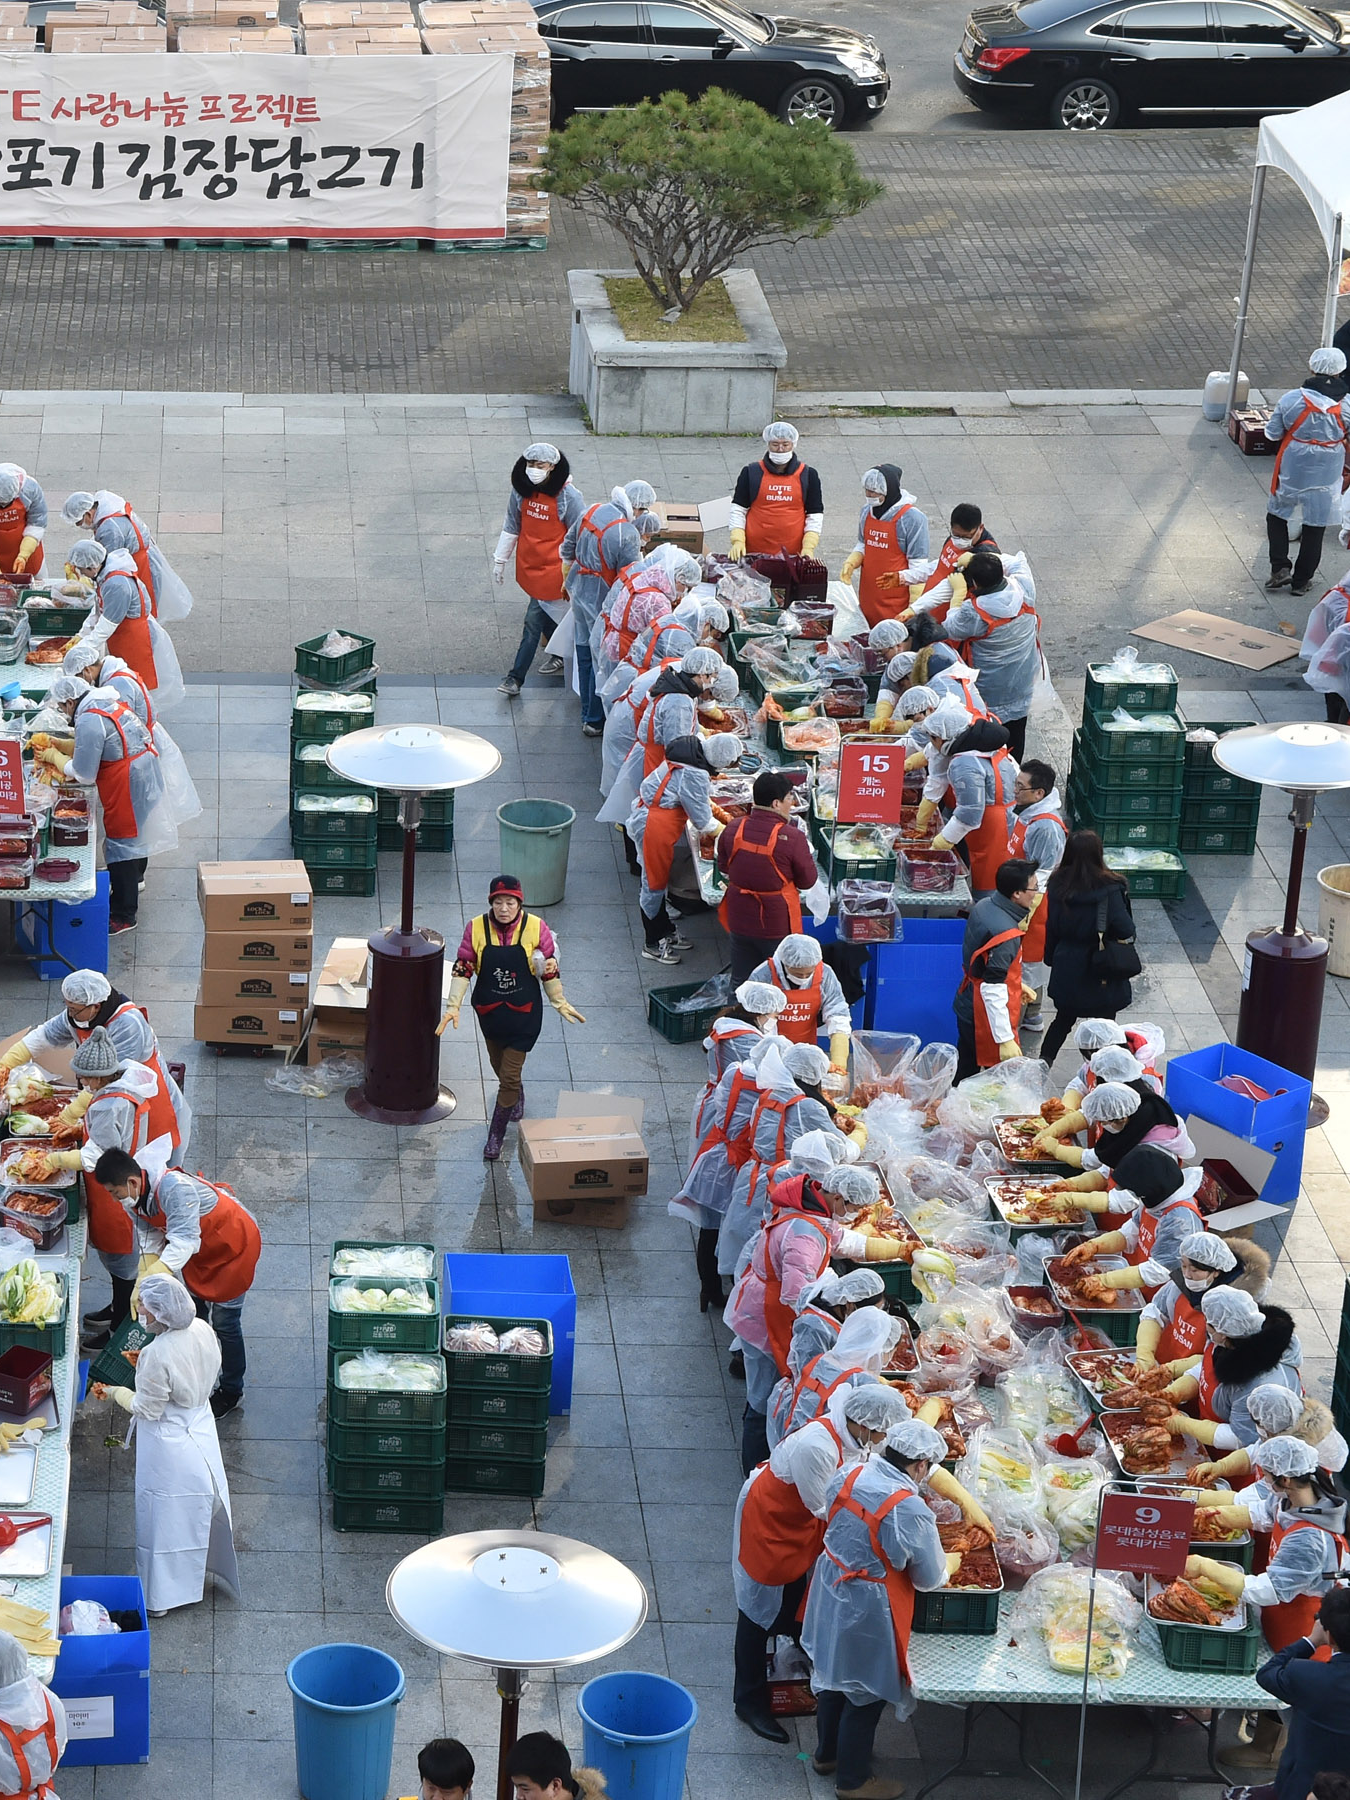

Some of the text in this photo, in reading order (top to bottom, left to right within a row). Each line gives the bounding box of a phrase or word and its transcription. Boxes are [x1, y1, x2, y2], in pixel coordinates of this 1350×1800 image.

[51, 91, 189, 127] 사랑나눔
[198, 94, 321, 128] 프로젝트
[766, 494, 793, 502] BUSAN
[528, 500, 549, 512] LOTTE
[526, 509, 549, 521] BUSAN
[869, 529, 889, 539] LOTTE
[866, 539, 889, 549] BUSAN
[858, 754, 890, 773] 15
[861, 777, 881, 787] 캐논
[855, 787, 886, 798] 코리아
[1134, 1506, 1162, 1525] 9
[1103, 1524, 1188, 1541] 롯데칠성음료
[1116, 1536, 1172, 1550] 롯데카드
